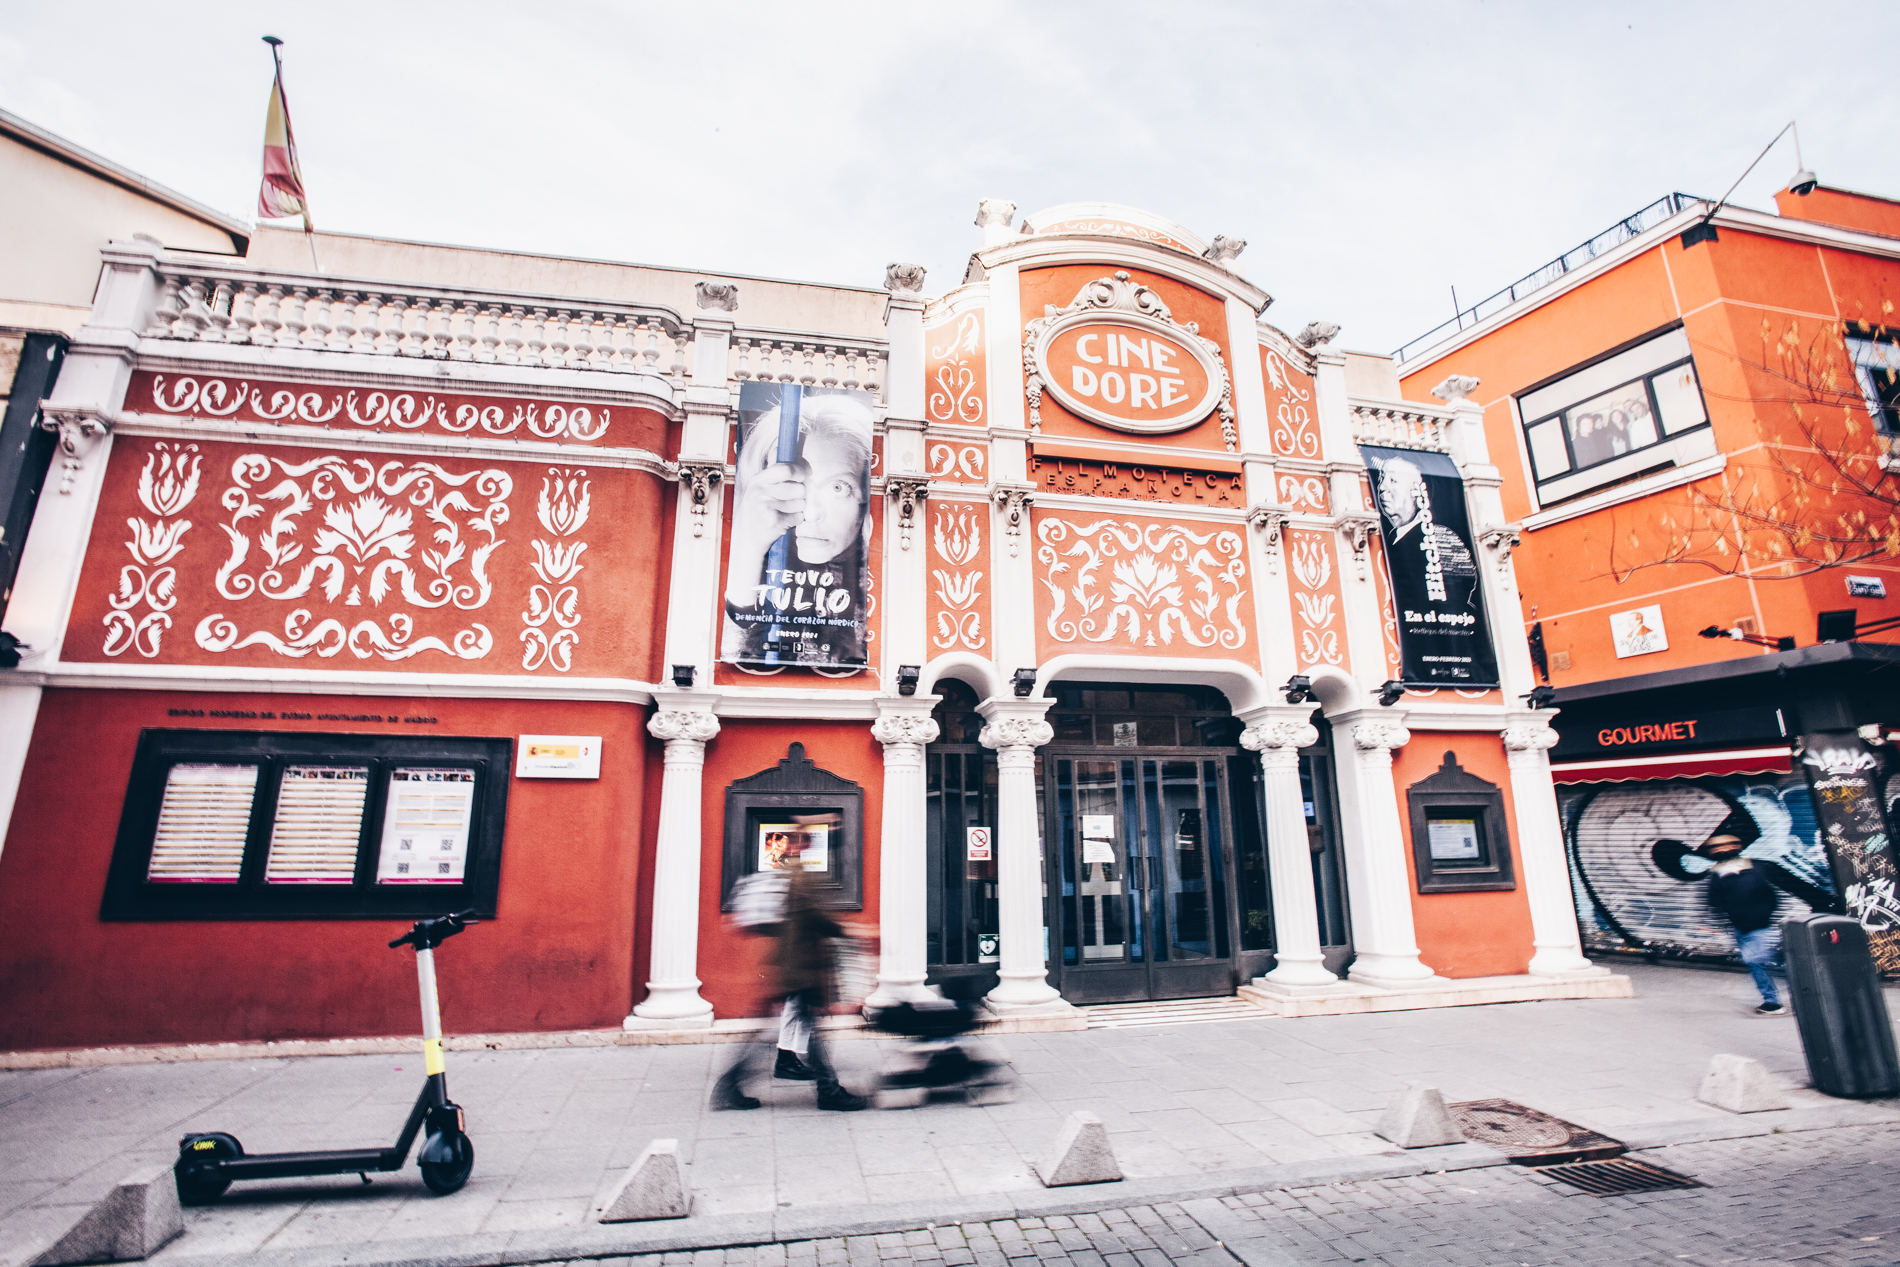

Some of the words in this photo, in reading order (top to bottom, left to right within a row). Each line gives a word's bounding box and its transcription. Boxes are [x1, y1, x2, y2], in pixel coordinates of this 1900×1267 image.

[1076, 333, 1180, 374] CINE
[1072, 365, 1189, 410] DORE
[1031, 458, 1242, 490] FILMOTECA
[1046, 473, 1229, 501] ESPAÑOLA
[1411, 481, 1447, 602] Hitchcock
[766, 569, 835, 587] TEUVO
[750, 584, 851, 617] TULIO
[776, 616, 790, 624] DEL
[1404, 610, 1423, 622] En
[1424, 610, 1437, 622] el
[1438, 612, 1476, 626] espejo
[1598, 720, 1698, 747] GOURMET
